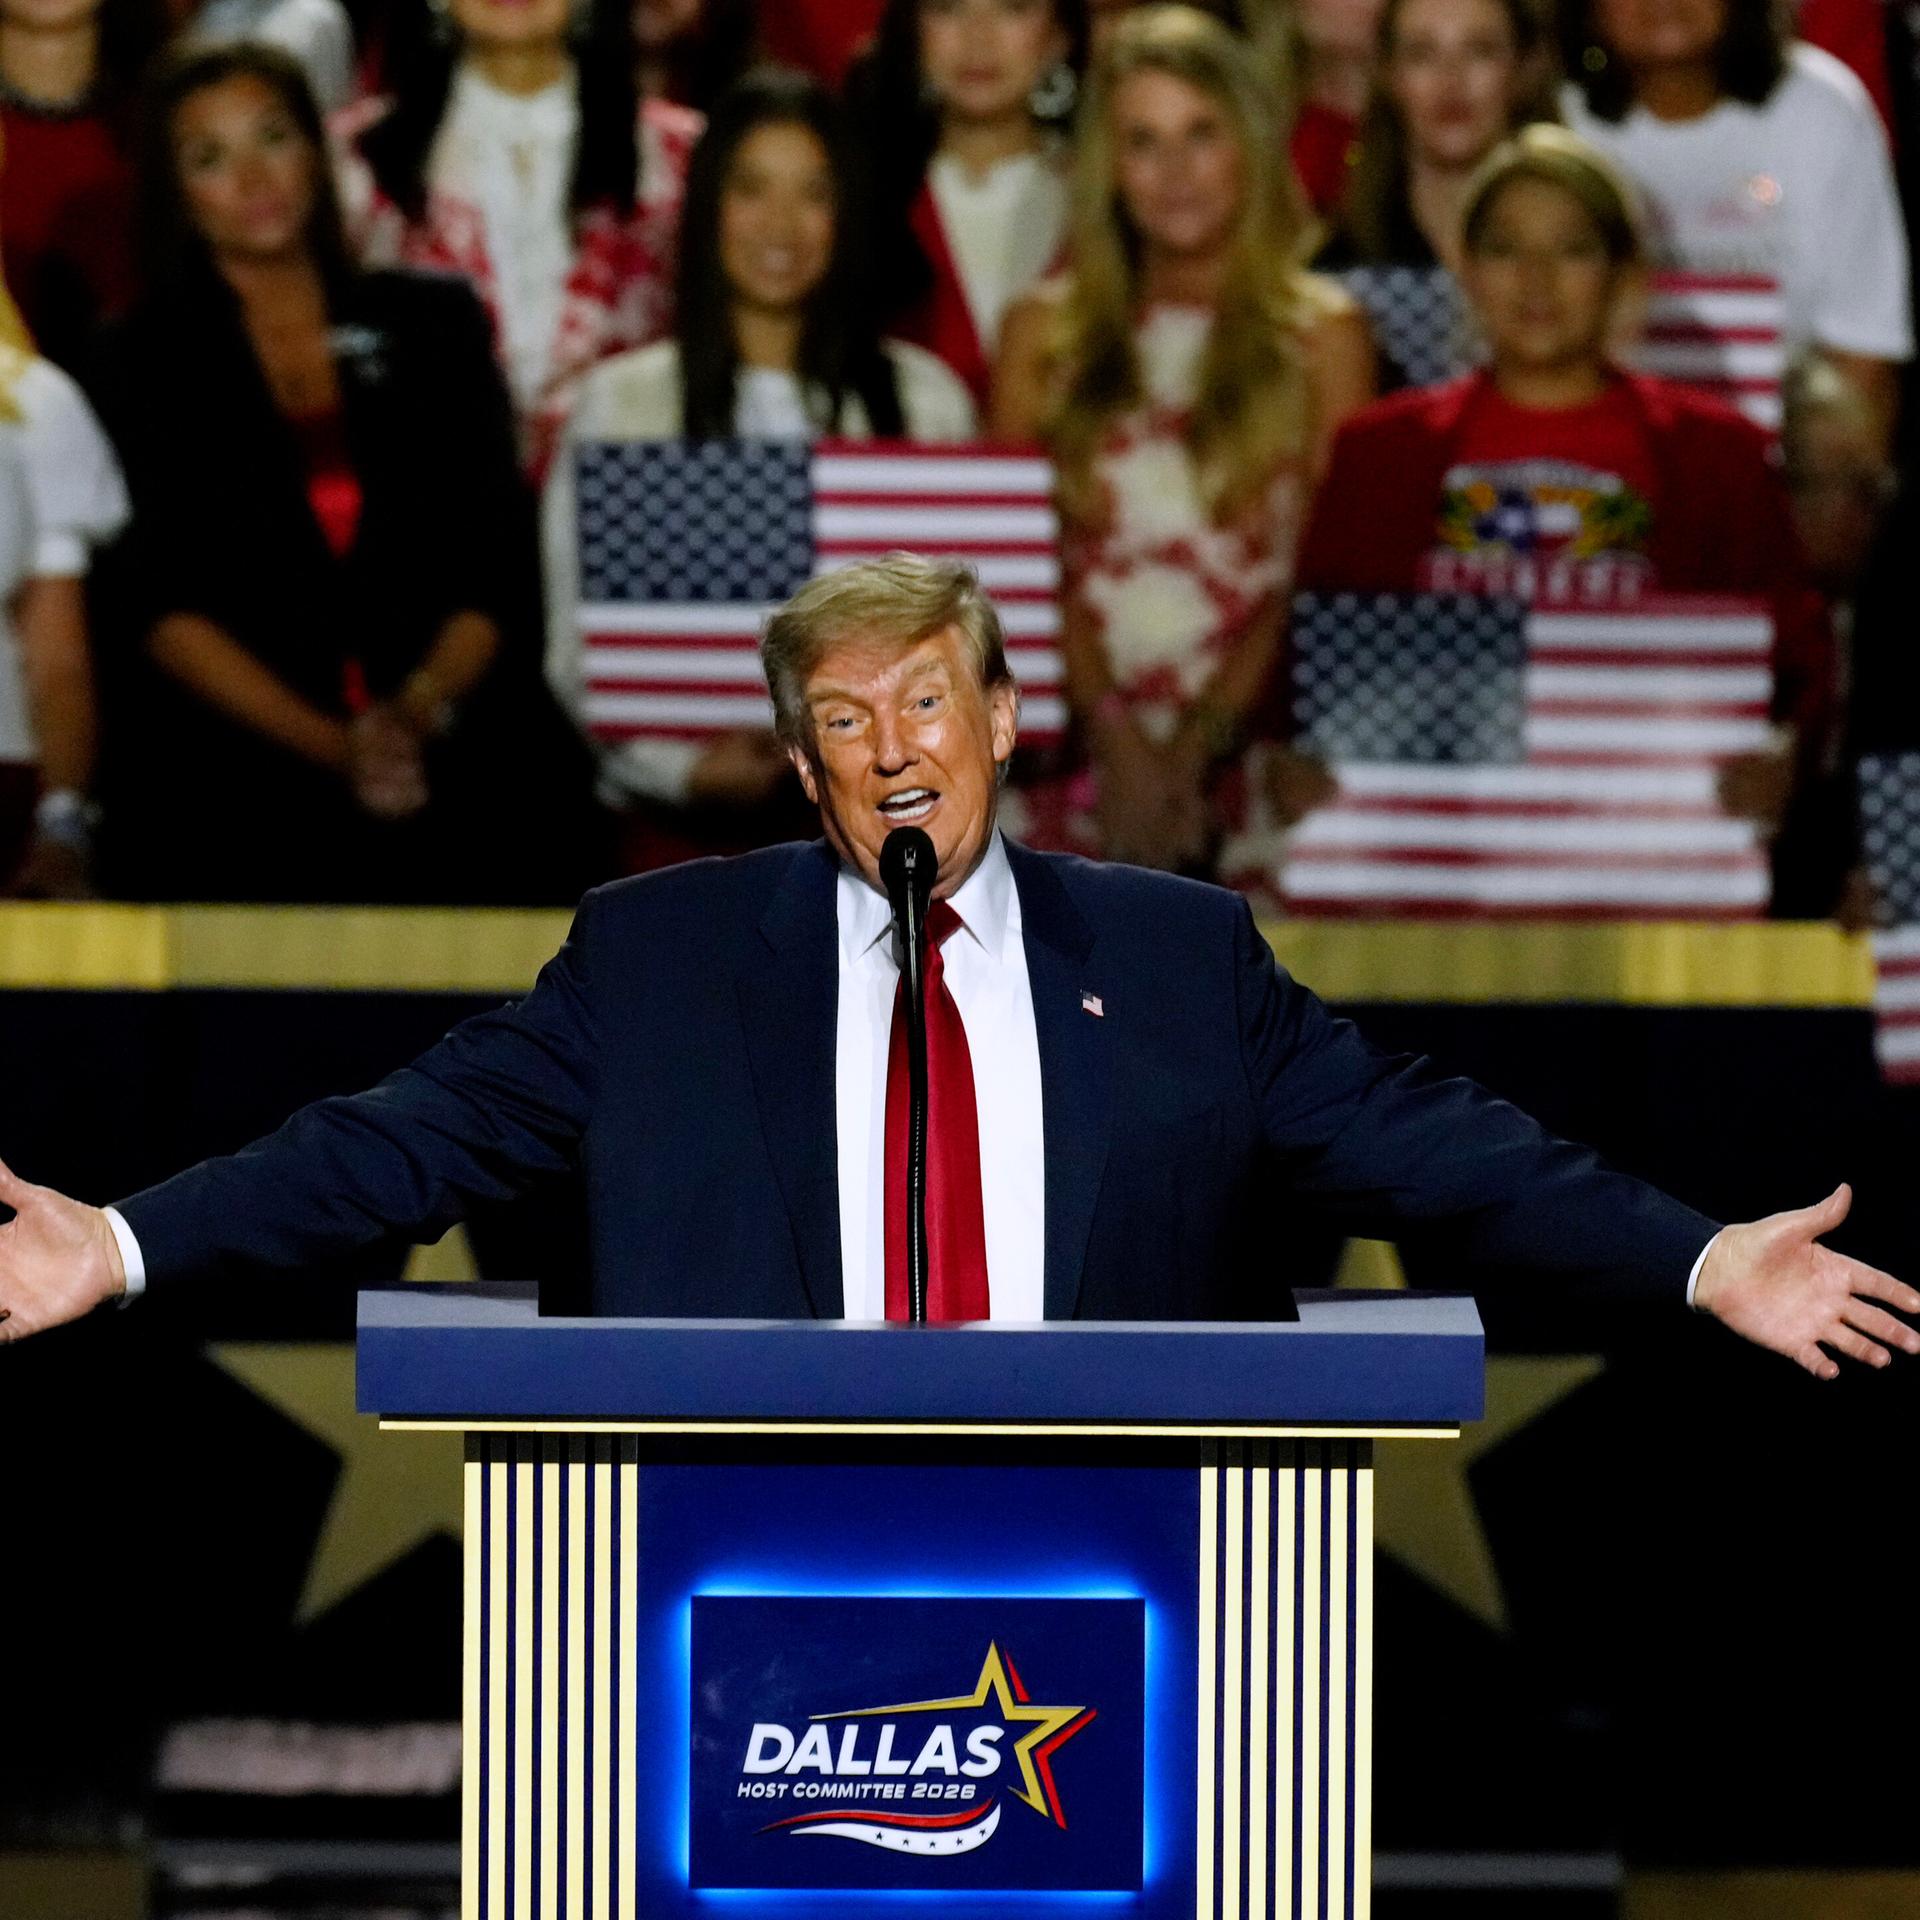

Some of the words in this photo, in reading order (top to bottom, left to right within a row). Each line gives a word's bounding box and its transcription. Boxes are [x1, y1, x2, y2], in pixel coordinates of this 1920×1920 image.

[743, 1723, 1005, 1777] DALLAS
[737, 1782, 789, 1799] HOST
[792, 1782, 906, 1799] COMMITTEE
[911, 1782, 976, 1800] 2026
